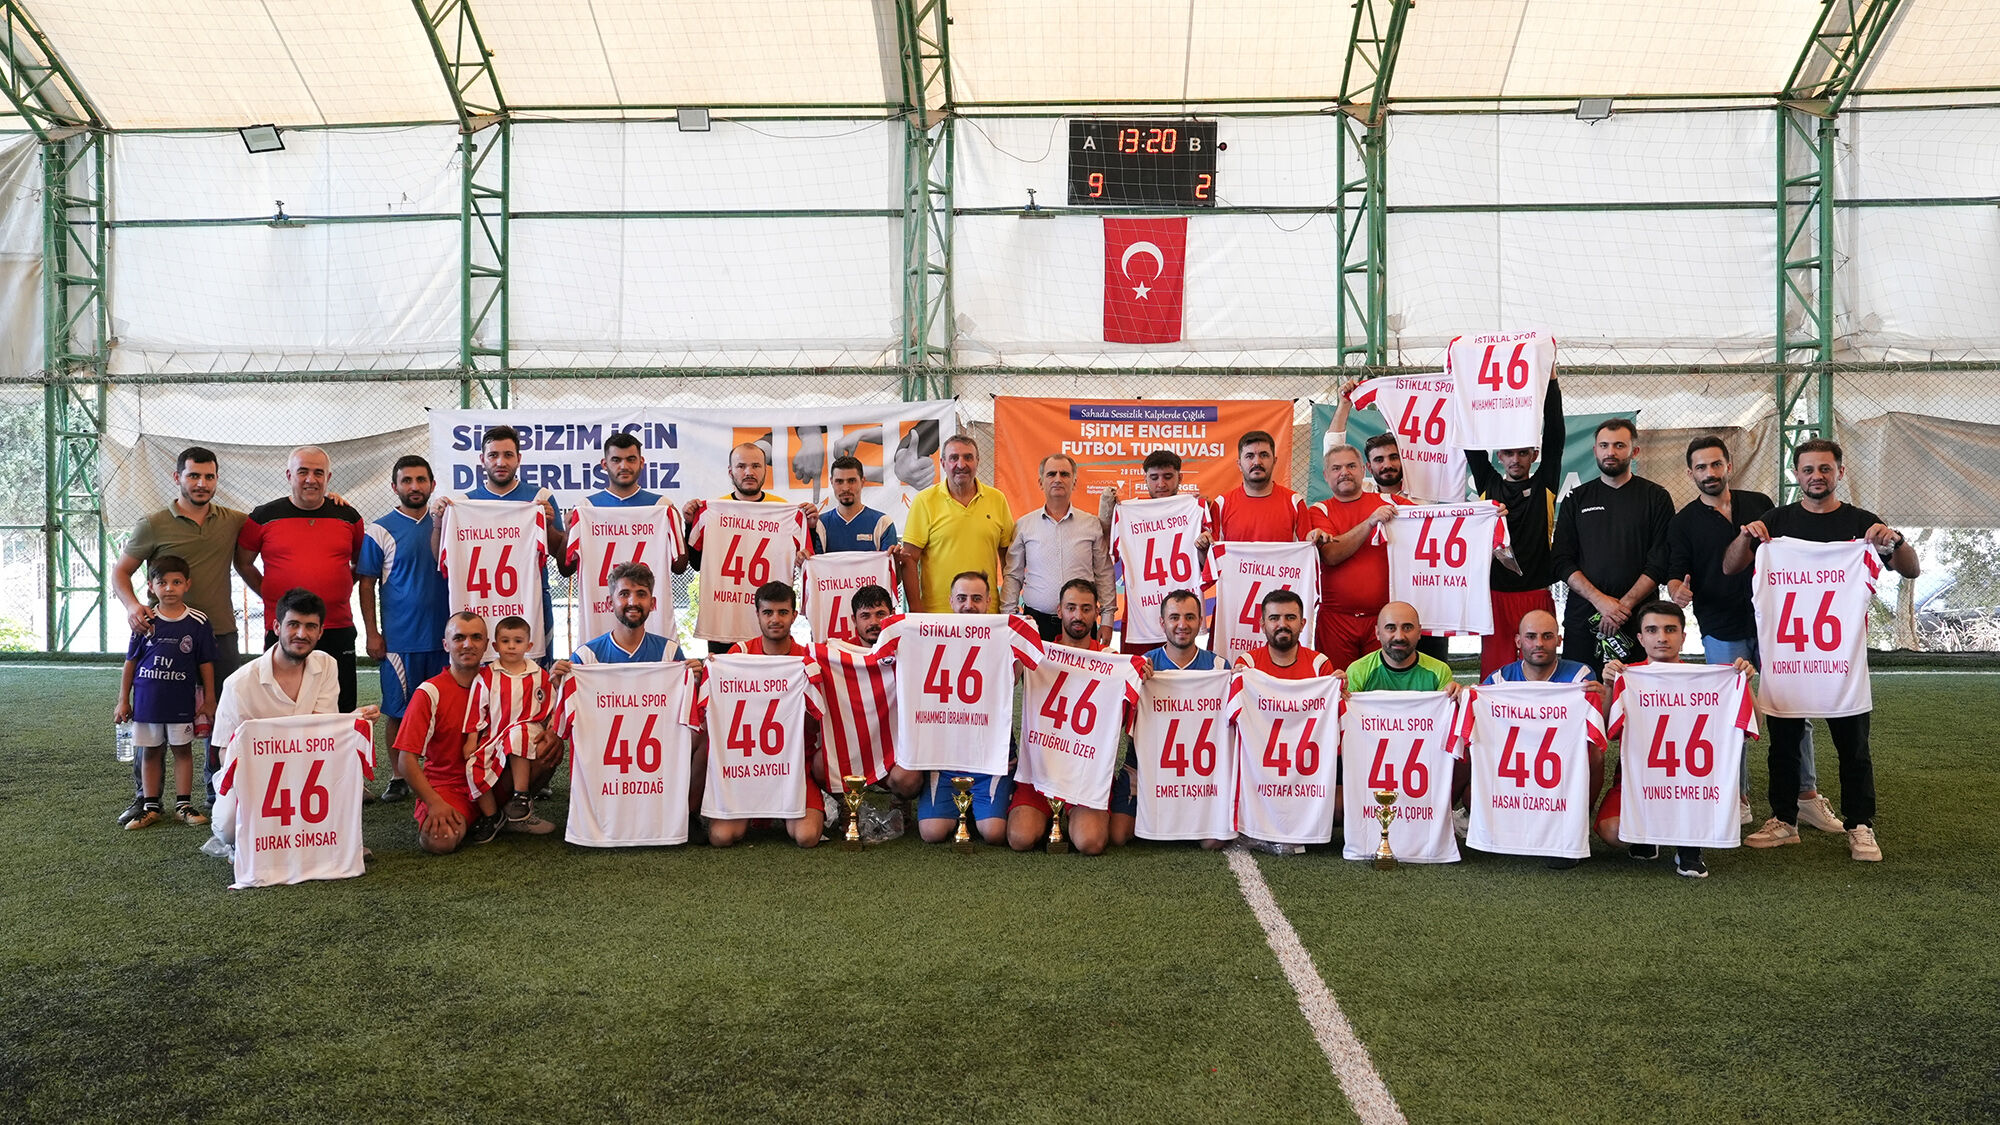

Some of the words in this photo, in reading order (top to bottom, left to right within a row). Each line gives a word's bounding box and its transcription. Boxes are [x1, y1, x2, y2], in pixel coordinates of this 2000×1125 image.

[1083, 136, 1096, 150] A
[1118, 128, 1177, 153] 13:20
[1190, 138, 1201, 152] B
[1088, 172, 1104, 198] 9
[1195, 174, 1211, 199] 2
[1476, 341, 1529, 391] 46
[1396, 377, 1431, 391] İSTİKLAL
[1081, 408, 1110, 418] Sahada
[1111, 409, 1142, 418] Sessizlik
[1144, 410, 1180, 421] Kalplerde
[1182, 410, 1206, 422] Çığlık
[1398, 396, 1447, 447] 46
[1080, 423, 1134, 439] İŞİTME
[1138, 424, 1206, 439] ENGELLİ
[1062, 441, 1126, 456] FUTBOL
[1417, 451, 1448, 464] KUMRU
[592, 522, 629, 536] İSTİKLAL
[632, 523, 654, 536] SPOR
[720, 516, 755, 530] İSTİKLAL
[758, 520, 780, 532] SPOR
[1130, 520, 1166, 535] İSTİKLAL
[1167, 515, 1188, 528] SPOR
[456, 526, 494, 541] İSTİKLAL
[497, 527, 520, 539] SPOR
[1413, 515, 1467, 568] 46
[719, 534, 771, 589] 46
[1142, 531, 1192, 586] 46
[466, 544, 518, 599] 46
[1240, 560, 1275, 577] İSTİKLAL
[1279, 566, 1301, 578] SPOR
[1767, 568, 1813, 586] İSTİKLAL
[1817, 569, 1845, 583] SPOR
[818, 576, 853, 591] İSTİKLAL
[1412, 572, 1440, 586] NİHAT
[1444, 576, 1467, 586] KAYA
[712, 589, 744, 605] MURAT
[492, 604, 524, 616] ERDEN
[1777, 590, 1842, 652] 46
[920, 622, 962, 638] İSTİKLAL
[966, 626, 991, 640] SPOR
[154, 656, 173, 668] Fly
[1047, 645, 1087, 668] İSTİKLAL
[1089, 659, 1114, 675] SPOR
[1773, 661, 1801, 674] KORKUT
[1803, 660, 1849, 677] KURTULMUŞ
[138, 666, 186, 680] Emirates
[924, 644, 983, 704] 46
[720, 677, 761, 694] İSTİKLAL
[764, 679, 788, 692] SPOR
[596, 692, 638, 708] İSTİKLAL
[642, 694, 667, 707] SPOR
[1039, 670, 1102, 737] 46
[1153, 696, 1194, 712] İSTİKLAL
[1198, 698, 1222, 711] SPOR
[1258, 695, 1299, 712] İSTİKLAL
[1302, 697, 1325, 711] SPOR
[1639, 690, 1687, 708] İSTİKLAL
[1690, 692, 1719, 706] SPOR
[916, 710, 946, 723] MUHAMMED
[947, 708, 969, 724] İBRAHİM
[1491, 701, 1536, 719] İSTİKLAL
[1540, 706, 1567, 719] SPOR
[727, 698, 784, 757] 46
[1361, 715, 1404, 731] İSTİKLAL
[1408, 718, 1433, 731] SPOR
[253, 737, 303, 756] İSTİKLAL
[304, 736, 336, 752] SPOR
[603, 714, 662, 774] 46
[1028, 730, 1071, 753] ERTUĞRUL
[1073, 739, 1095, 759] ÖZER
[1161, 718, 1216, 777] 46
[1263, 718, 1320, 776] 46
[1648, 714, 1714, 777] 46
[1498, 726, 1562, 789] 46
[722, 765, 750, 778] MUSA
[753, 763, 790, 776] SAYGILI
[1368, 738, 1428, 798] 46
[261, 760, 329, 826] 46
[601, 779, 618, 795] ALİ
[622, 778, 664, 795] BOZDAĞ
[1156, 785, 1179, 798] EMRE
[1182, 784, 1218, 801] TAŞKIRAN
[1295, 784, 1325, 797] SAYGILI
[1643, 786, 1672, 800] YUNUS
[1675, 786, 1699, 800] EMRE
[1702, 786, 1720, 804] DAŞ
[1493, 795, 1520, 808] HASAN
[1522, 793, 1567, 811] ÖZARSLAN
[1405, 806, 1433, 822] ÇOPUR
[256, 835, 291, 852] BURAK
[295, 829, 337, 848] SİMSAR
